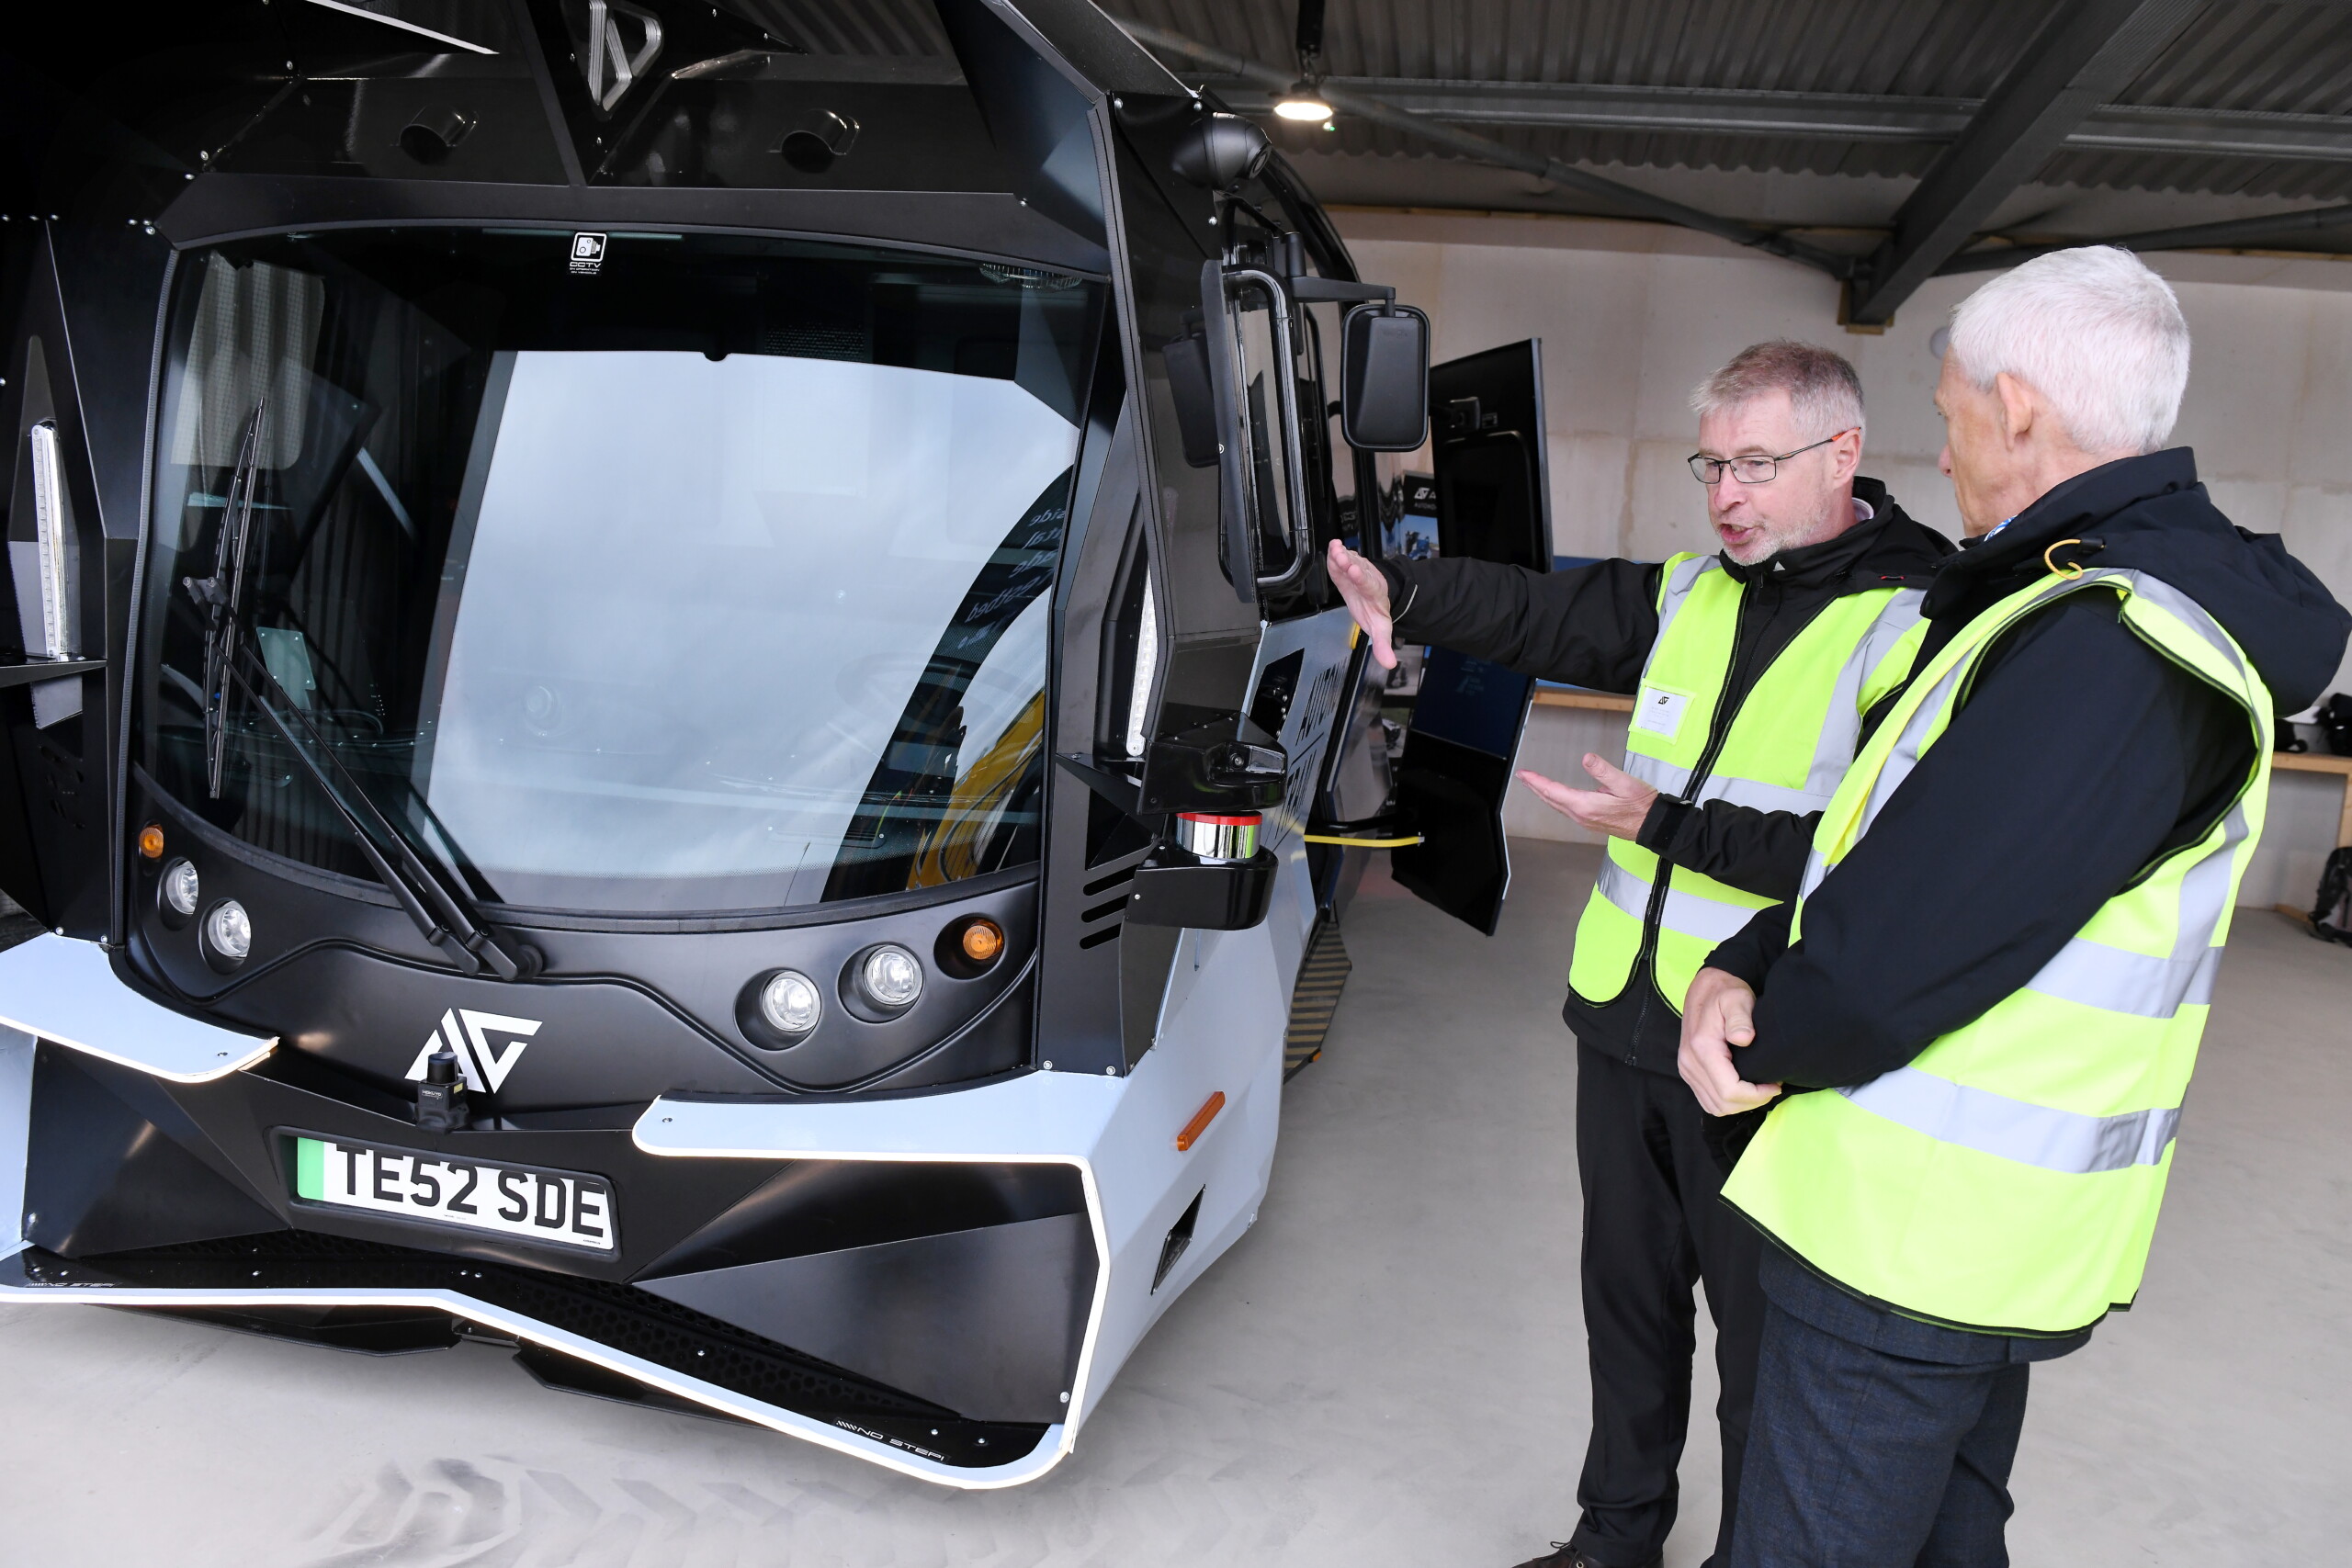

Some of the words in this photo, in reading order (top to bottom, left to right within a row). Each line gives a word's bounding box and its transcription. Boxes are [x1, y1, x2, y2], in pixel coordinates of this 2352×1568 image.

[336, 1143, 478, 1215] TE52
[497, 1169, 605, 1238] SDE
[857, 1427, 883, 1439] NO
